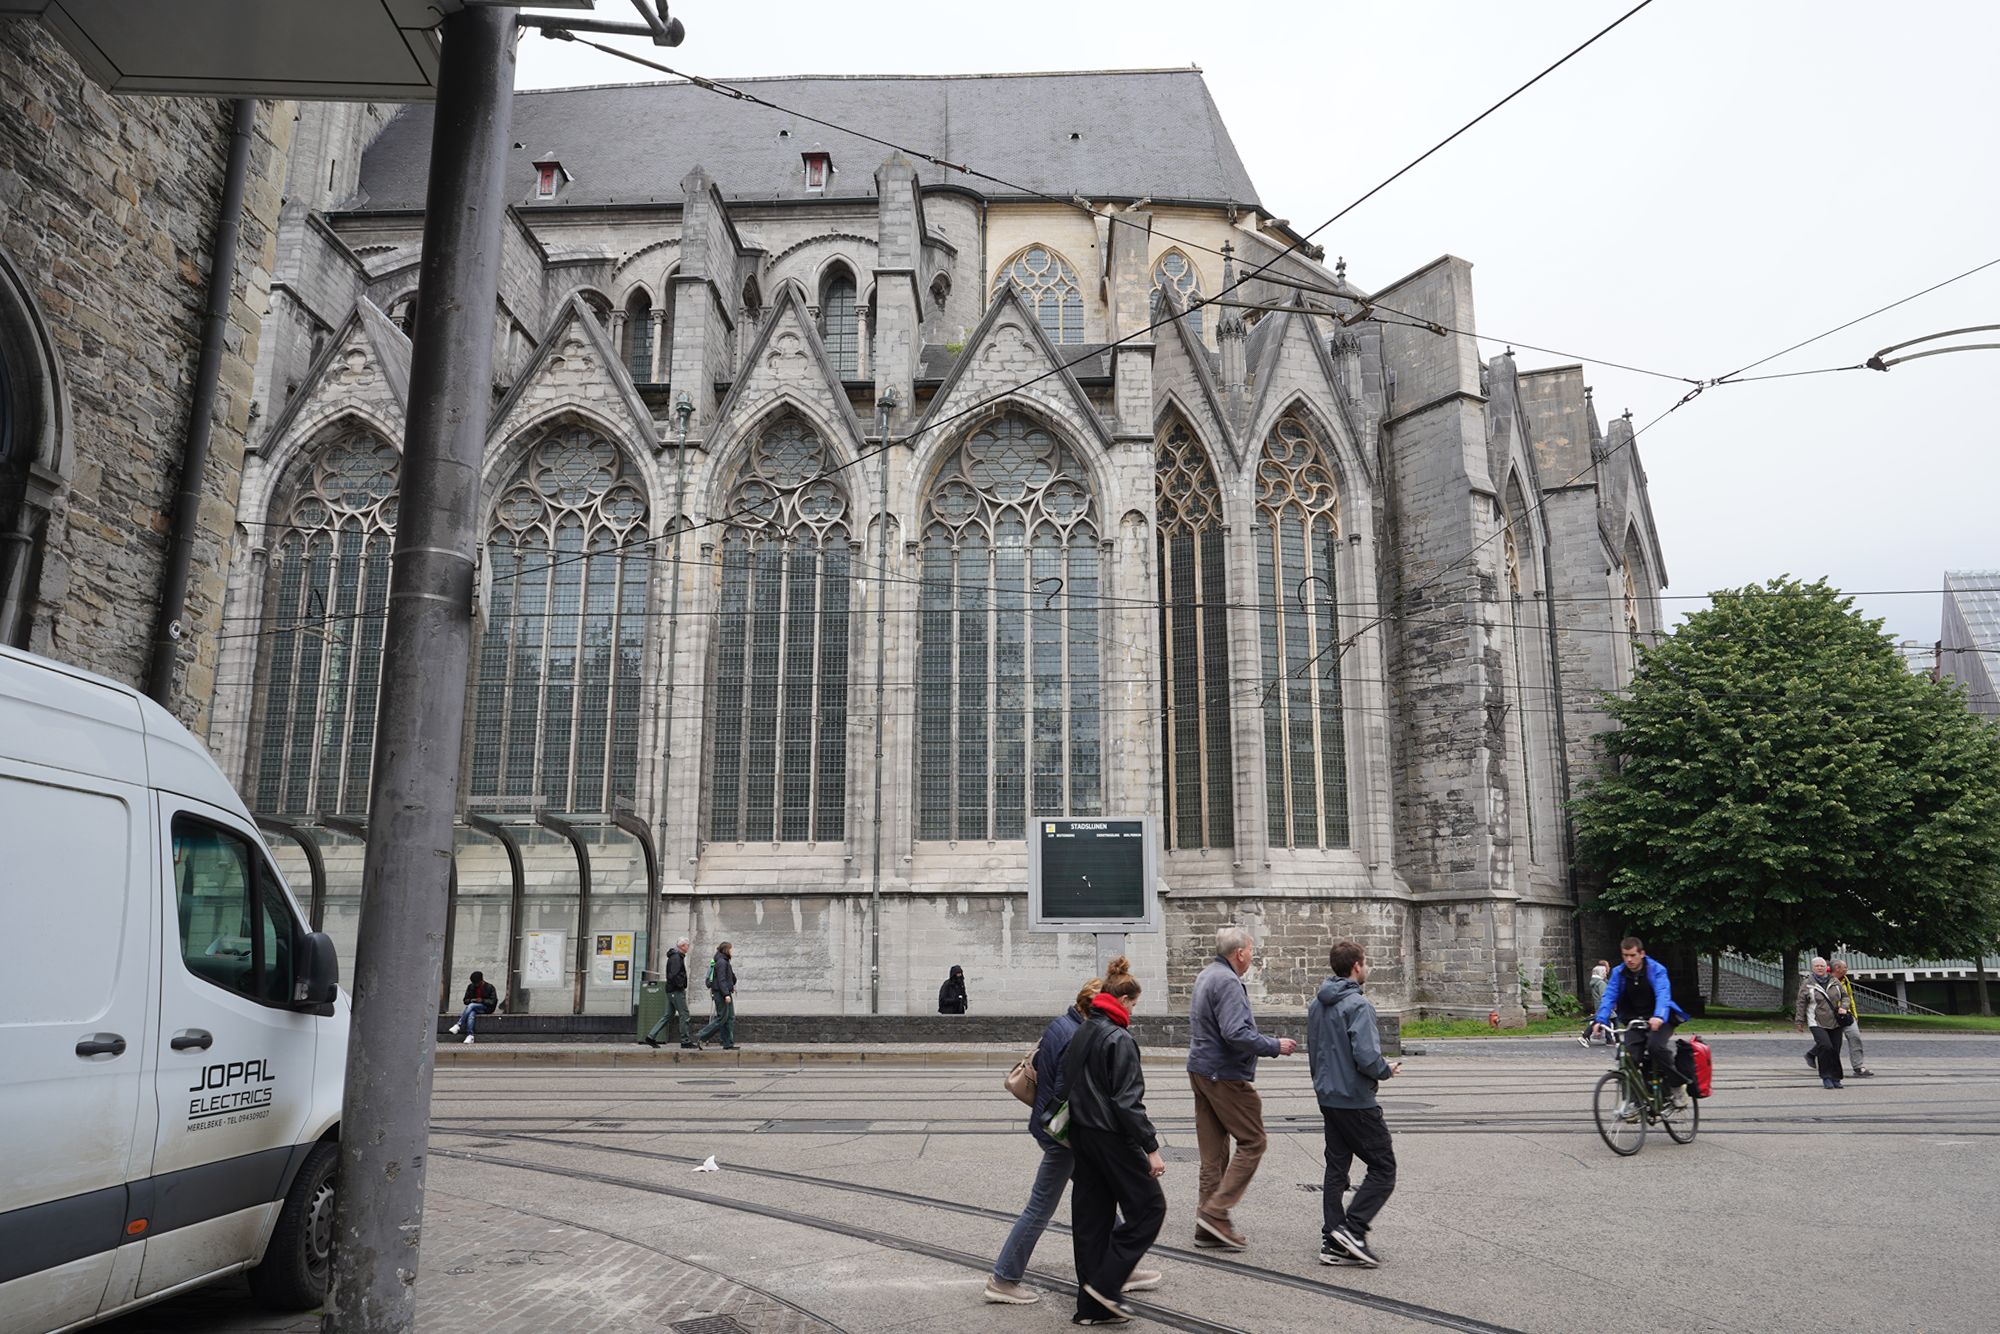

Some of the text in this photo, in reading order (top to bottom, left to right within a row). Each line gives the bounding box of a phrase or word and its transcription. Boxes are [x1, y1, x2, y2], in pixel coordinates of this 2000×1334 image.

[189, 1058, 275, 1092] JOPAL
[189, 1088, 272, 1114] ELECTRICS
[186, 1119, 223, 1132] MERELBEKE
[227, 1116, 237, 1125] TEL
